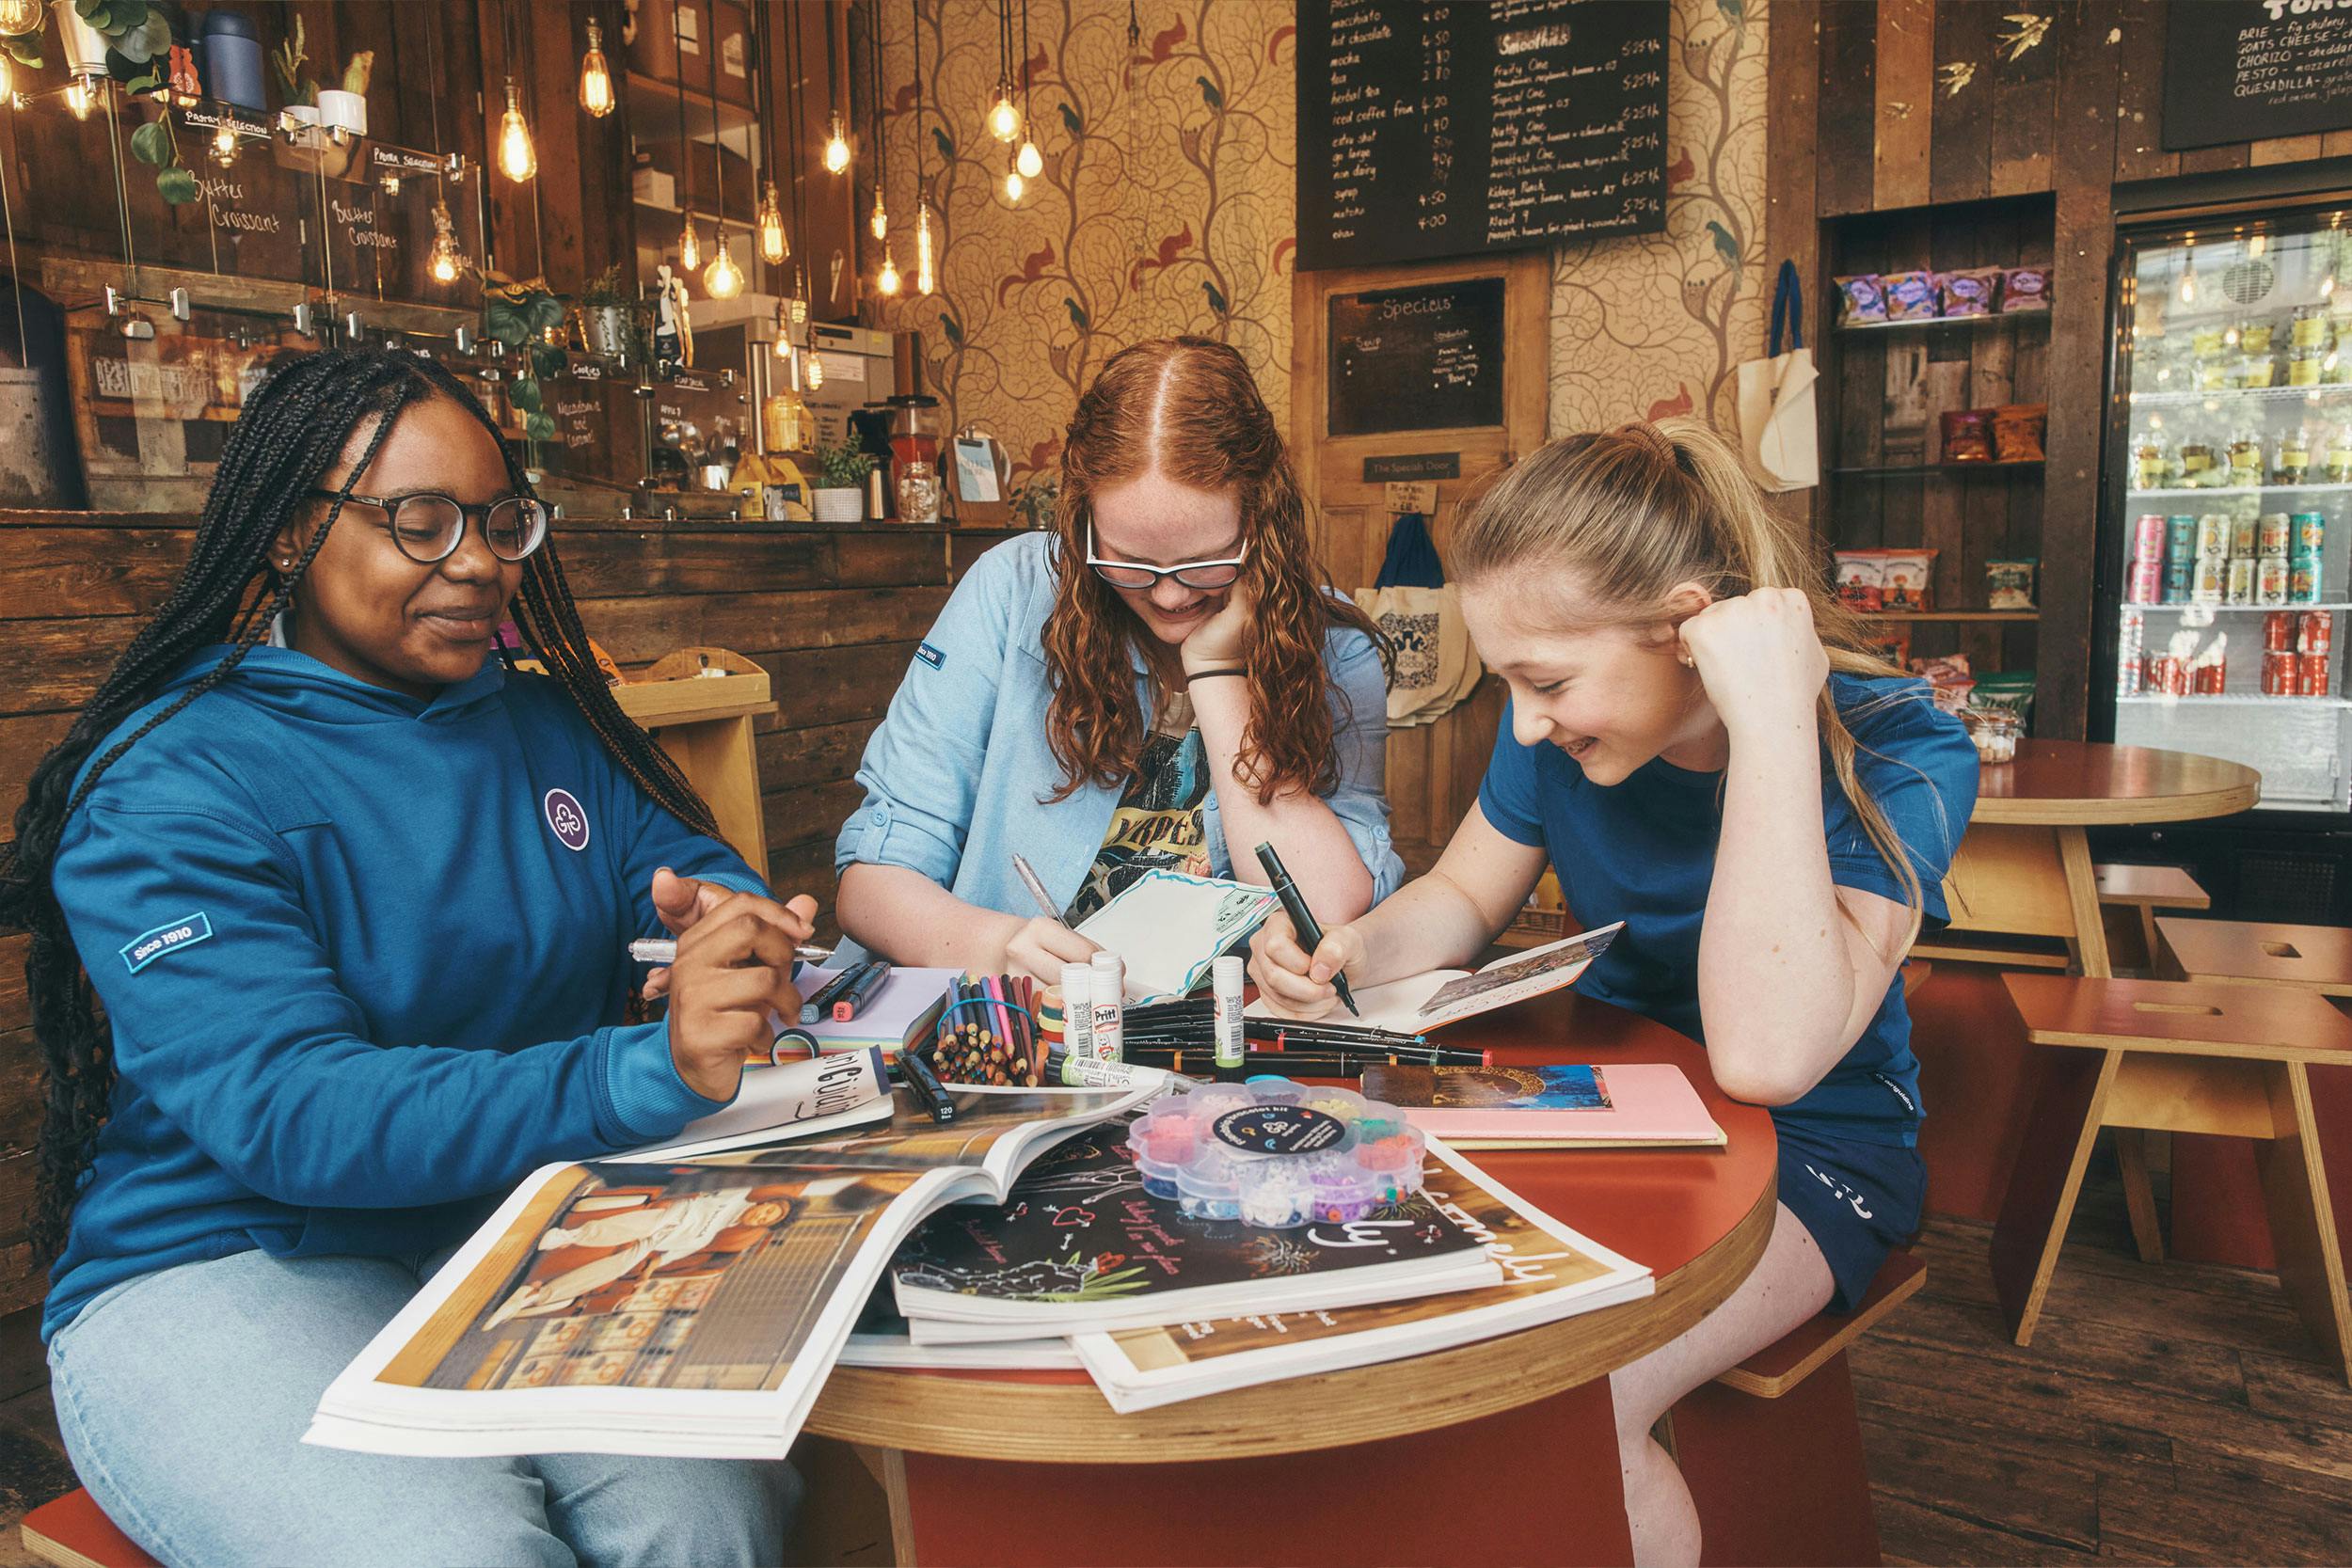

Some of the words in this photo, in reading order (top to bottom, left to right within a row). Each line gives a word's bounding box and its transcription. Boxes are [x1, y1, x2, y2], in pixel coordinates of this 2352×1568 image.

[2238, 26, 2268, 40] BRIE
[2287, 21, 2301, 36] fig
[1499, 26, 1570, 55] Smoothies
[2236, 39, 2275, 55] GOATS
[2280, 31, 2329, 47] CHEESE
[1528, 58, 1549, 71] One
[2237, 51, 2291, 69] CHORIZO
[2236, 67, 2278, 83] PESTO
[1527, 88, 1546, 100] One
[185, 112, 220, 126] PASTRY
[227, 119, 267, 134] SELECTION
[1333, 110, 1353, 125] iced
[1357, 105, 1386, 122] coffee
[1526, 120, 1546, 133] One
[1536, 148, 1555, 160] One
[1353, 163, 1376, 181] dairy
[187, 170, 244, 202] Butter
[212, 204, 279, 233] Croissant
[332, 200, 373, 224] Butter
[348, 227, 398, 248] Croissant
[1383, 297, 1452, 320] Specials
[1356, 337, 1381, 348] Soup
[572, 363, 601, 377] Cookies
[134, 940, 162, 959] Since
[161, 927, 192, 944] 1910
[1095, 1009, 1116, 1022] Pritt
[941, 1106, 953, 1115] 120
